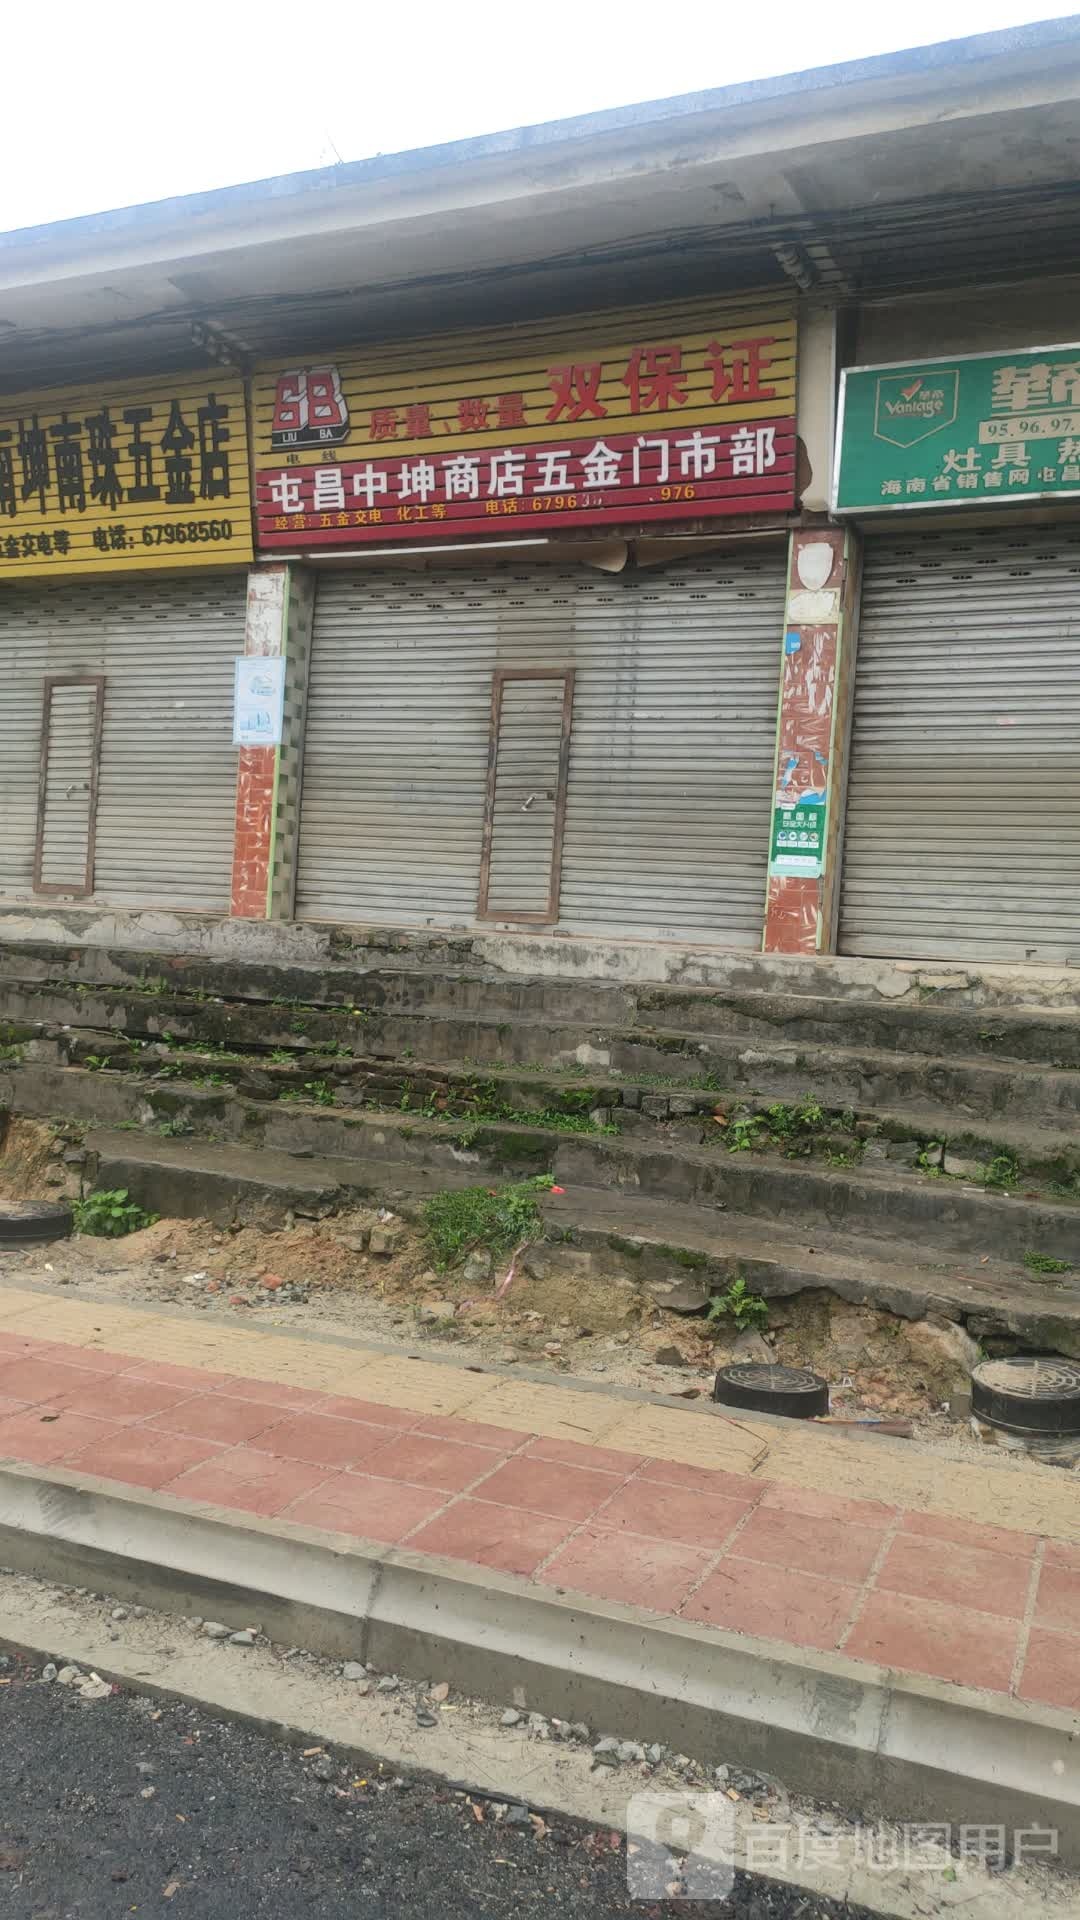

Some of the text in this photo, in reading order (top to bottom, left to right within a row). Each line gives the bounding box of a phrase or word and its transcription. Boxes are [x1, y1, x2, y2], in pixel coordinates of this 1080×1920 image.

[545, 336, 776, 422] 双保证
[282, 430, 333, 442] LIU BA
[269, 427, 776, 513] 屯昌中坤商店五金门市部
[397, 503, 447, 522] 化工等
[0, 530, 70, 558] 金交电等
